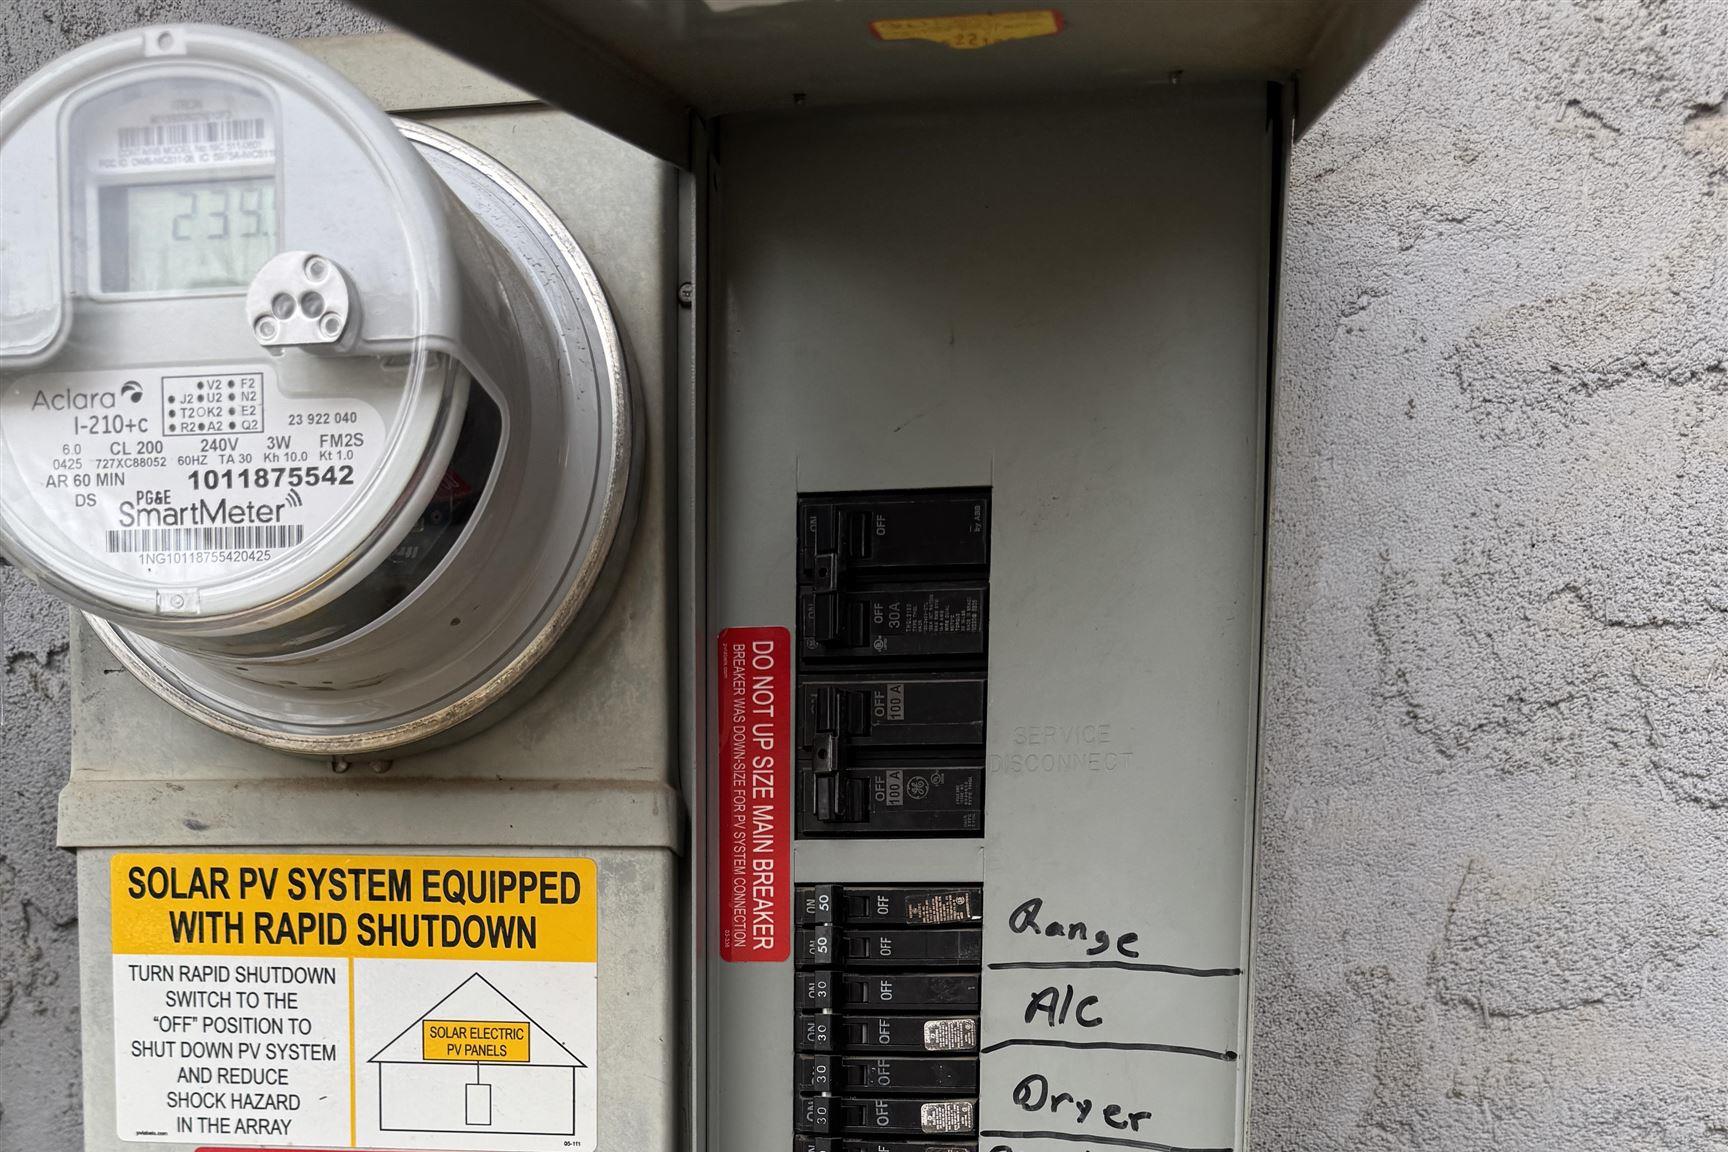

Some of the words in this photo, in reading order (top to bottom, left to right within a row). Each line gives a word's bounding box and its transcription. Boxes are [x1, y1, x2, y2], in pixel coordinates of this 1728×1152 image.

[32, 388, 116, 411] Aclara
[74, 414, 148, 435] I-210+c
[288, 412, 303, 426] 23
[307, 412, 330, 425] 922
[334, 411, 357, 424] 040
[62, 443, 82, 455] 6.0
[110, 441, 131, 455] CL
[136, 440, 164, 454] 200
[200, 437, 239, 452] 240V
[266, 435, 291, 450] 3W
[319, 432, 364, 448] FM2S
[53, 458, 82, 470] 0425
[95, 456, 167, 469] 727XC88052
[177, 455, 208, 466] 60HZ
[219, 454, 236, 465] TA
[238, 453, 253, 464] 30
[264, 453, 280, 463] Kh
[284, 451, 308, 462] 10.0
[319, 451, 332, 461] Kt
[337, 450, 354, 460] 1.0
[45, 473, 69, 488] AR
[73, 473, 91, 487] 60
[96, 472, 125, 487] MIN
[188, 465, 354, 490] 1011875542
[75, 493, 97, 508] DS
[136, 489, 171, 506] PG&E
[119, 498, 286, 528] SmartMeter
[874, 603, 883, 624] OFF
[889, 602, 900, 629] 30A
[752, 640, 775, 670] DO
[732, 643, 746, 696] BREAKER
[752, 676, 775, 718] NOT
[732, 698, 746, 724] WAS
[752, 723, 775, 751] UP
[1013, 724, 1111, 745] SERVICE
[732, 725, 746, 788] DOWN-SIZE
[990, 752, 1133, 773] DISCONNECT
[752, 755, 775, 799] SIZE
[732, 789, 746, 814] FOR
[732, 815, 746, 831] PV
[752, 804, 775, 853] MAIN
[732, 831, 746, 875] SYSTEM
[128, 866, 231, 900] SOLAR
[240, 867, 279, 900] PV
[287, 867, 411, 901] SYSTEM
[423, 869, 581, 906] EQUIPPED
[732, 875, 747, 948] CONNECTION
[752, 858, 775, 950] BREAKER
[819, 894, 829, 912] 50
[877, 895, 889, 915] OFF
[169, 911, 244, 944] WITH
[255, 912, 347, 946] RAPID
[357, 913, 537, 949] SHUTDOWN
[1009, 898, 1139, 958] Range
[880, 936, 892, 956] OFF
[128, 965, 174, 982] TURN
[179, 965, 231, 983] RAPID
[235, 966, 337, 984] SHUTDOWN
[817, 981, 827, 997] 30
[880, 980, 893, 1001] OFF
[166, 991, 232, 1009] SWITCH
[236, 991, 260, 1009] TO
[264, 992, 298, 1009] THE
[203, 1017, 283, 1035] POSITION
[288, 1018, 312, 1035] TO
[429, 1026, 467, 1040] SOLAR
[470, 1027, 524, 1041] ELECTRIC
[131, 1040, 176, 1058] SHUT
[180, 1041, 233, 1059] DOWN
[239, 1043, 261, 1060] PV
[266, 1043, 337, 1061] SYSTEM
[447, 1043, 462, 1056] PV
[464, 1044, 507, 1057] PANELS
[177, 1067, 212, 1084] AND
[218, 1068, 289, 1085] REDUCE
[167, 1091, 226, 1109] SHOCK
[231, 1093, 301, 1110] HAZARD
[1013, 1073, 1152, 1132] Dryer
[177, 1117, 193, 1133] IN
[197, 1117, 230, 1134] THE
[235, 1118, 292, 1135] ARRAY
